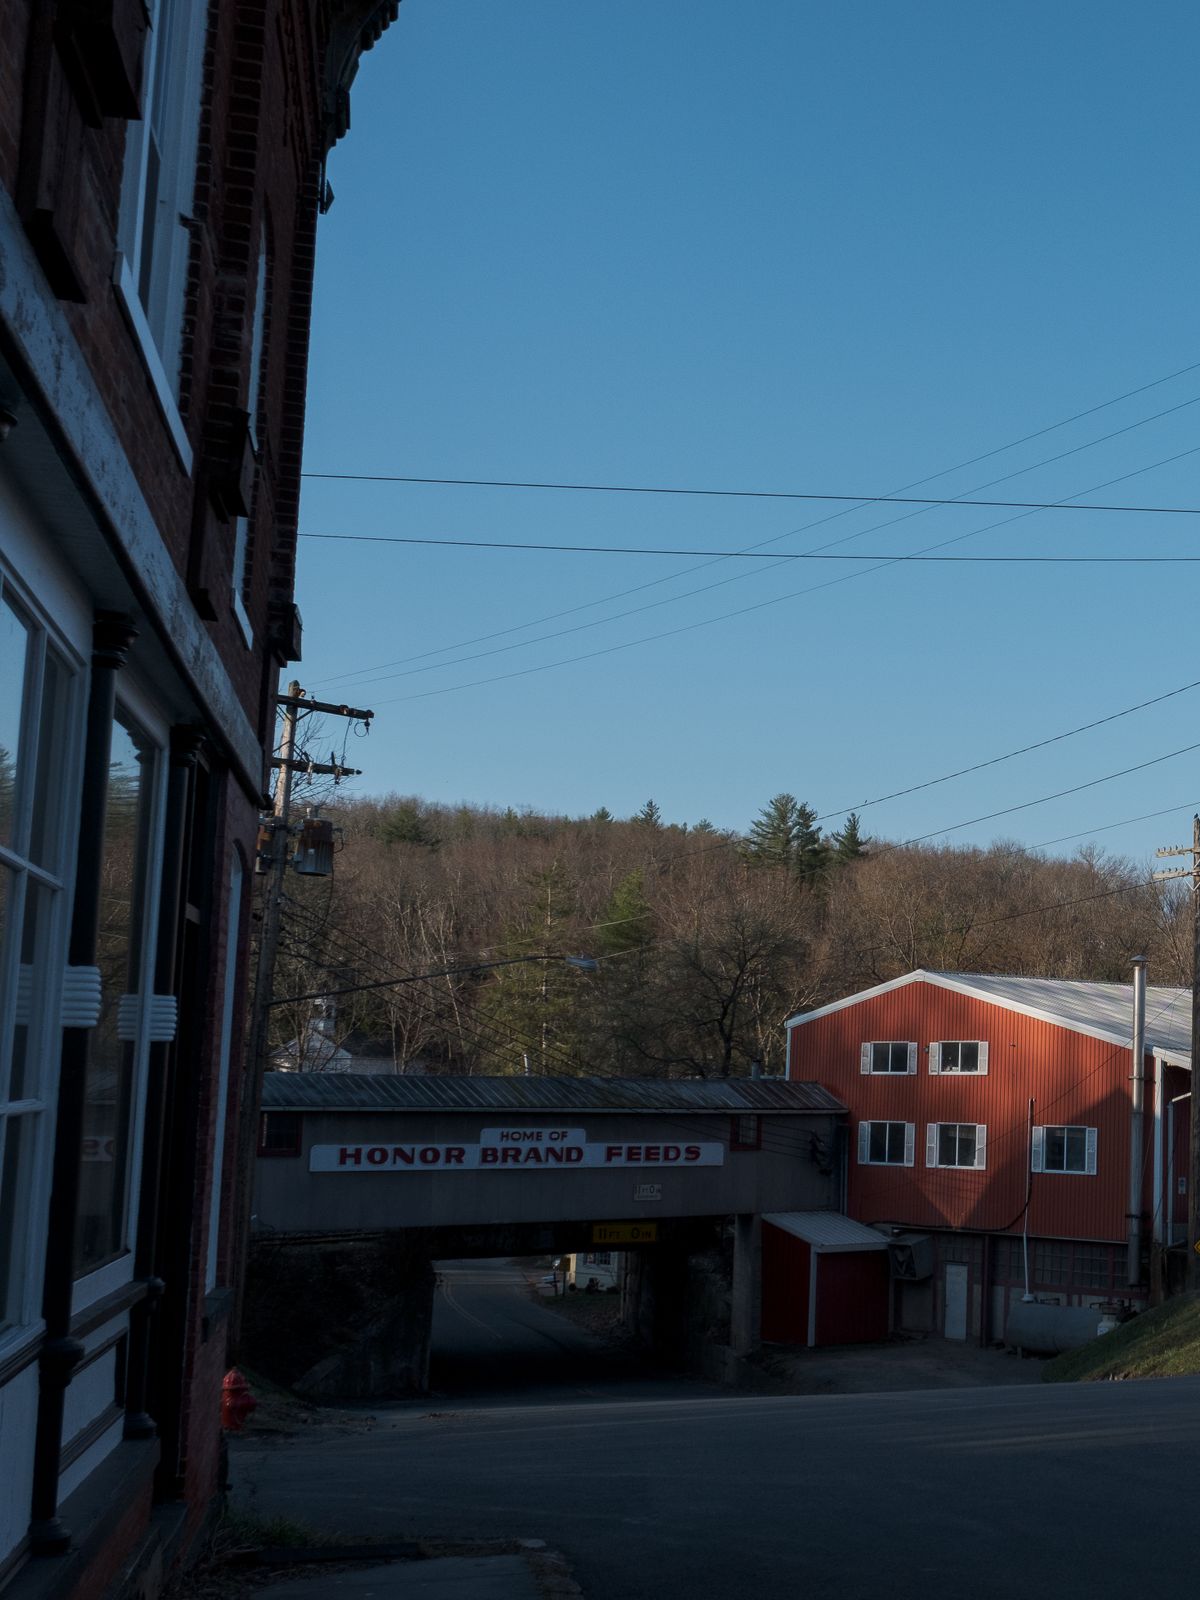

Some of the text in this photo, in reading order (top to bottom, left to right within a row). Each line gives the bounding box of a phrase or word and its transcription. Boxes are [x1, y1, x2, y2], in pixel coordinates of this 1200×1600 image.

[500, 1131, 568, 1142] HOME OF
[338, 1145, 702, 1165] HONOR BRAND FEEDS
